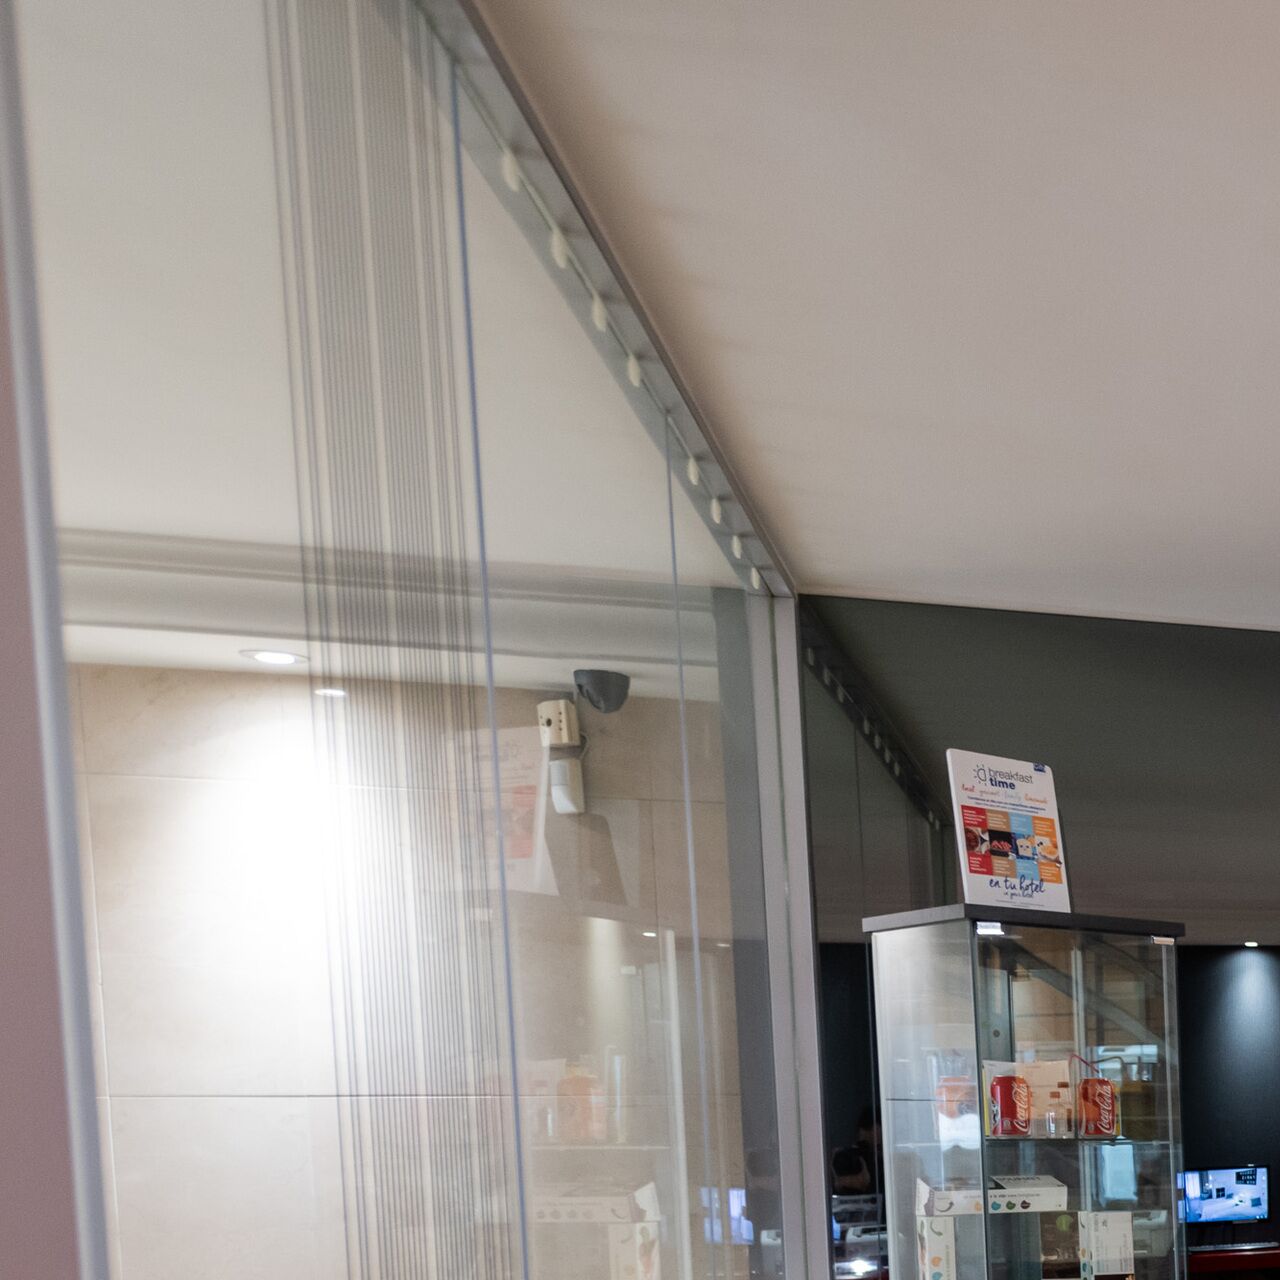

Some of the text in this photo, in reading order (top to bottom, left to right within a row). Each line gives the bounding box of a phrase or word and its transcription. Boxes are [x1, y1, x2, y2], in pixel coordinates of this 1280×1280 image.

[988, 767, 1033, 784] breakfast
[989, 777, 1016, 790] time
[989, 874, 1046, 893] en tu hotel
